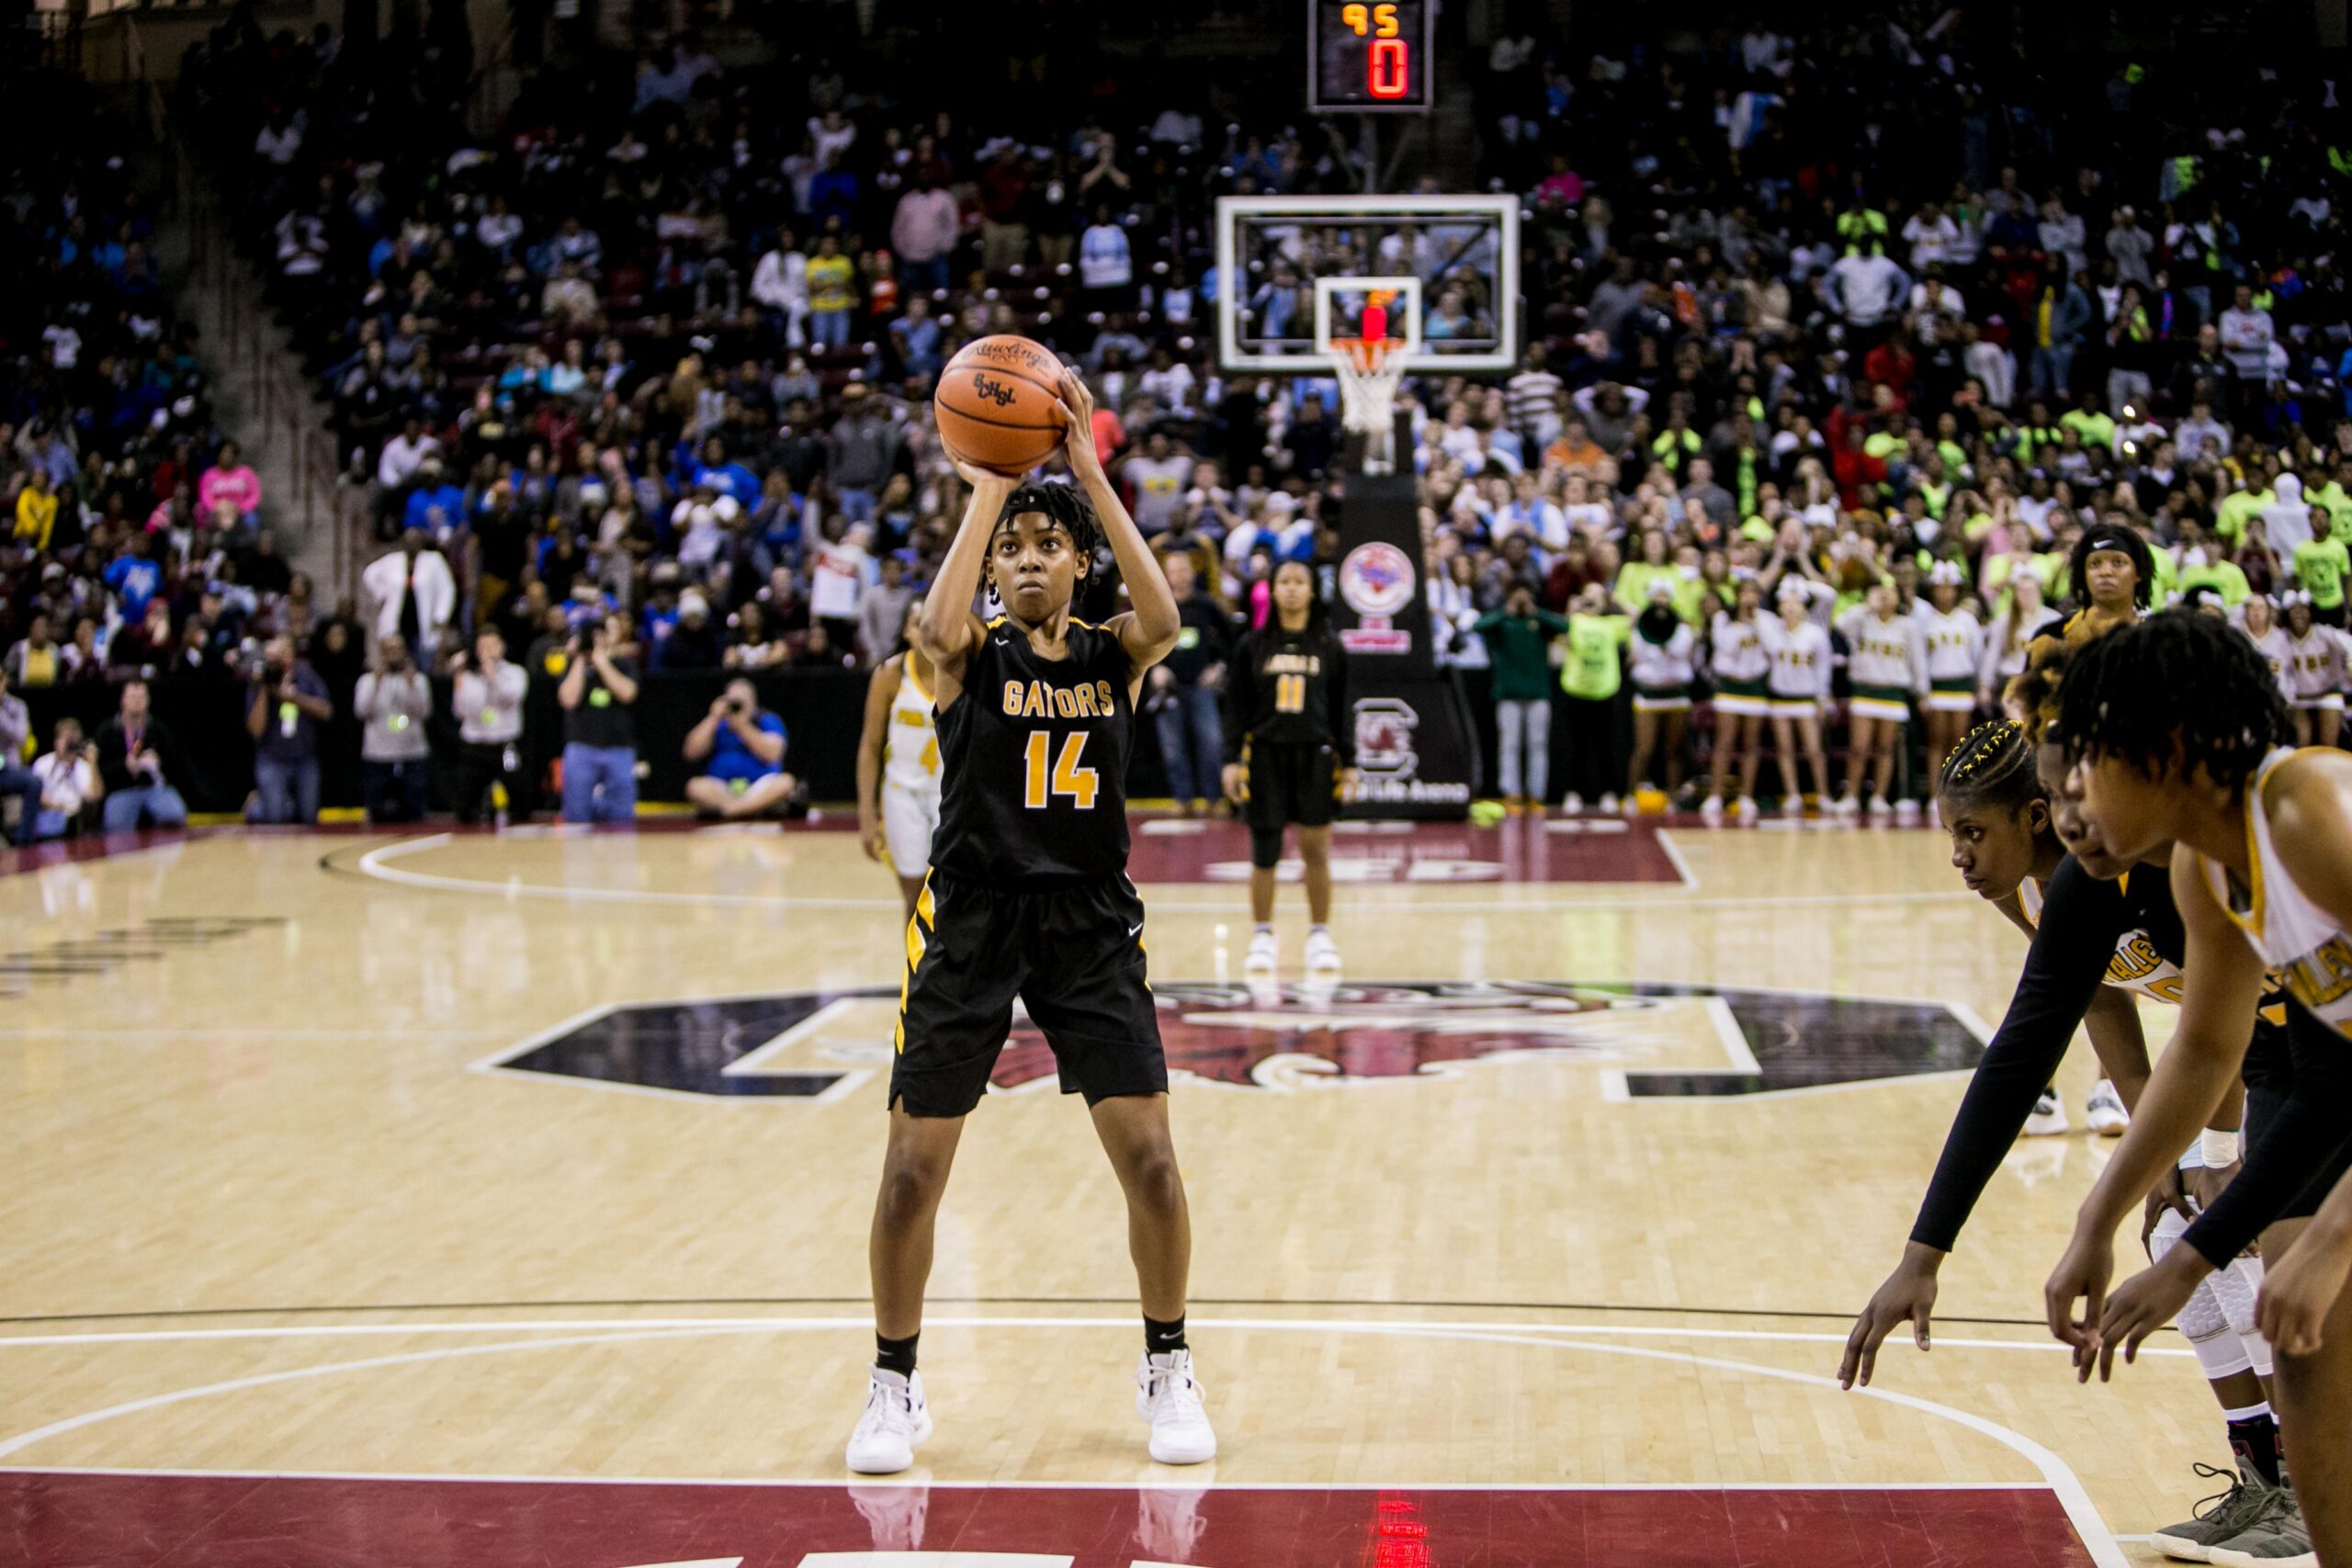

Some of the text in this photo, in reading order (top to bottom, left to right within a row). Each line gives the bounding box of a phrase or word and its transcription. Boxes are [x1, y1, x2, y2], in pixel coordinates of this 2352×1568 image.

[1368, 39, 1408, 98] 0
[973, 372, 1016, 407] SCHSL
[1003, 680, 1114, 718] GATORS
[1275, 673, 1306, 714] 11
[1023, 730, 1100, 809] 14
